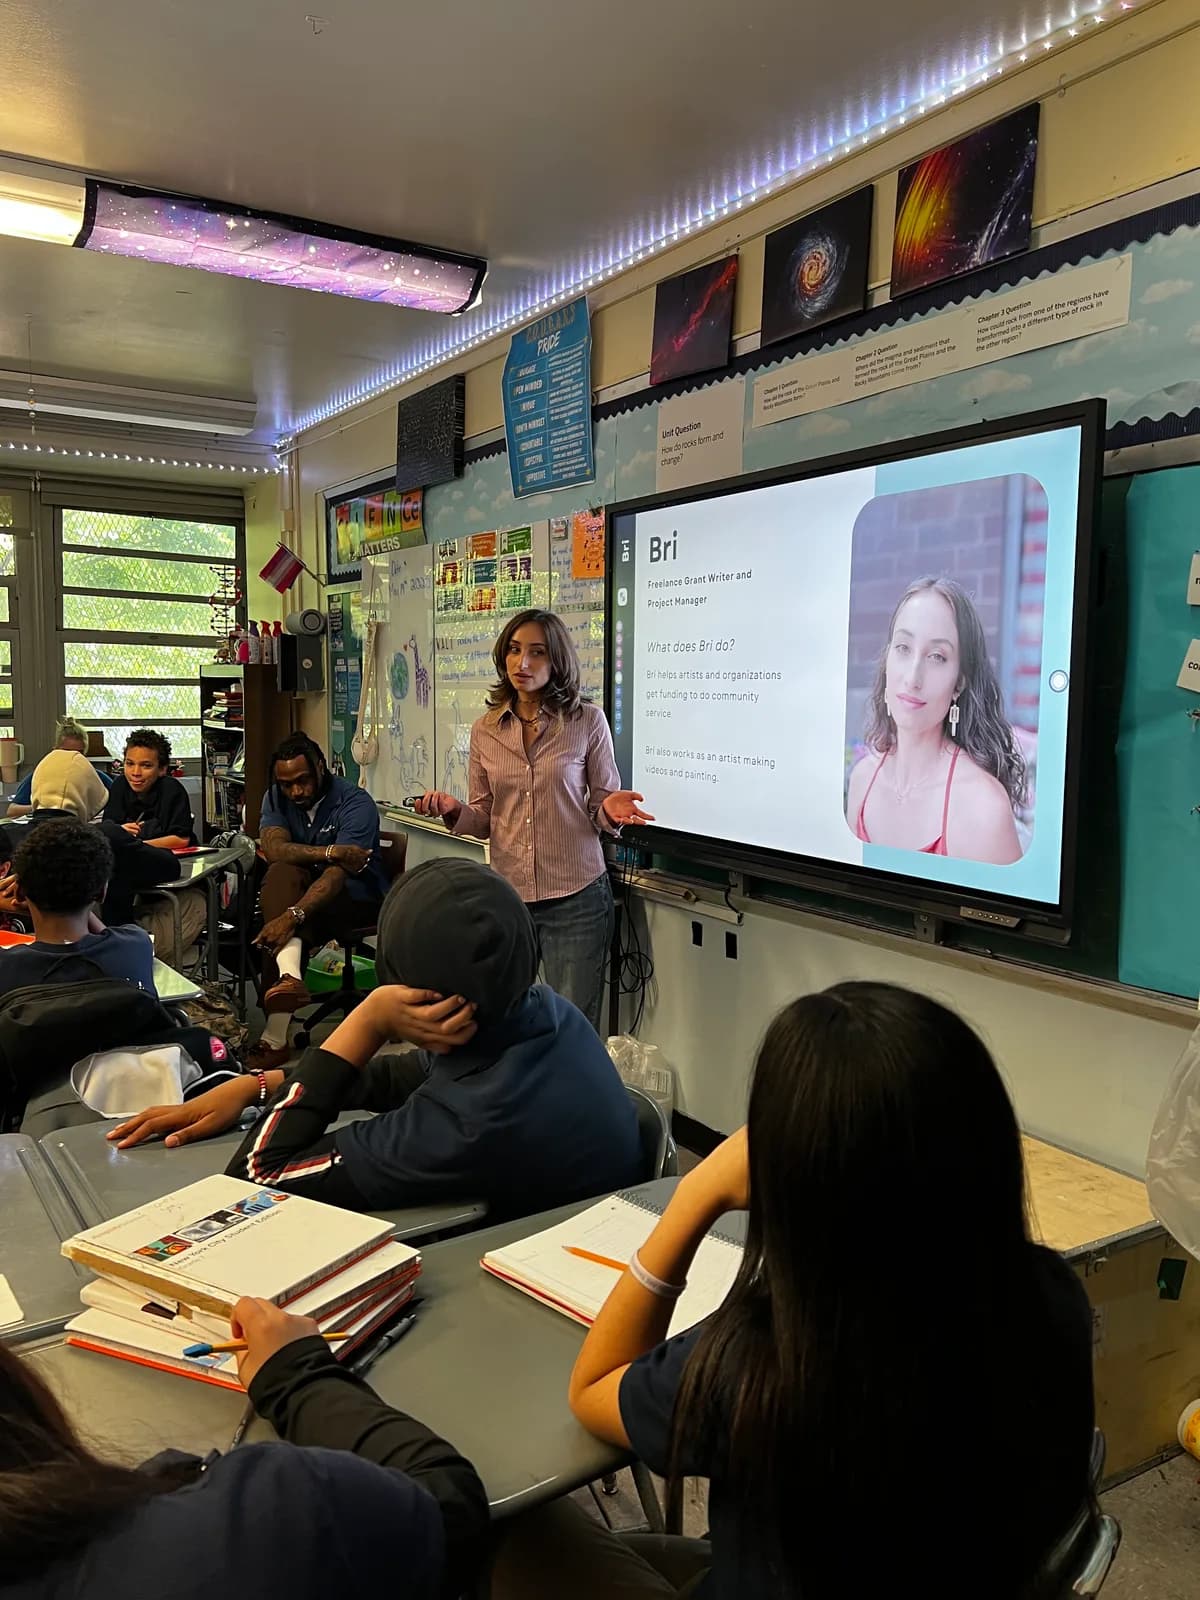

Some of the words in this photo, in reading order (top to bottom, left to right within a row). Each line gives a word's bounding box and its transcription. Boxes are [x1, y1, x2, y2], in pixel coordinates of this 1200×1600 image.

[977, 326, 989, 335] How
[989, 321, 1005, 331] could
[1005, 316, 1017, 325] rock
[1018, 312, 1033, 321] from
[1033, 308, 1046, 316] one
[1046, 304, 1055, 312] of
[1055, 301, 1065, 310] the
[1066, 294, 1092, 307] regions
[1093, 289, 1109, 299] have
[978, 312, 999, 324] Chapter
[1000, 308, 1005, 316] 3
[1005, 301, 1032, 315] Question
[976, 328, 1010, 344] transformed
[1010, 322, 1021, 332] into
[1027, 314, 1054, 327] different
[1055, 310, 1070, 320] type
[1071, 307, 1079, 315] of
[1079, 303, 1094, 313] rock
[1095, 300, 1103, 308] in
[537, 331, 561, 357] PRIDE
[877, 343, 898, 355] Question
[938, 338, 950, 346] that
[976, 344, 985, 352] the
[985, 339, 1000, 349] other
[1001, 331, 1022, 345] region?
[903, 355, 919, 364] Great
[662, 428, 674, 438] Unit
[675, 422, 701, 436] Question
[661, 445, 673, 454] How
[674, 442, 681, 451] do
[682, 439, 697, 449] rocks
[697, 435, 712, 445] form
[712, 431, 724, 442] and
[661, 453, 683, 466] change?
[621, 539, 630, 562] Bri
[649, 530, 678, 563] Bri
[647, 579, 683, 589] Freelance
[684, 576, 706, 585] Grant
[708, 571, 734, 583] Writer
[736, 569, 752, 580] and
[647, 597, 673, 609] Project
[675, 595, 708, 607] Manager
[647, 640, 671, 653] What
[673, 640, 697, 652] does
[699, 638, 714, 652] Bri
[715, 638, 736, 651] do?
[646, 670, 656, 679] Bri
[657, 670, 677, 681] helps
[679, 669, 703, 680] artists
[705, 670, 720, 680] and
[722, 669, 782, 681] organizations
[646, 690, 658, 700] get
[659, 689, 688, 701] funding
[689, 690, 698, 700] to
[699, 690, 710, 700] do
[711, 690, 759, 703] community
[645, 709, 671, 718] service
[645, 745, 655, 755] Bri
[656, 746, 671, 757] also
[672, 749, 694, 759] works
[696, 751, 705, 760] as
[707, 752, 717, 761] an
[718, 753, 741, 764] artist
[743, 755, 775, 769] making
[645, 765, 668, 776] videos
[669, 767, 684, 778] and
[684, 769, 719, 784] painting.
[169, 1256, 190, 1267] New
[190, 1247, 208, 1260] York
[207, 1237, 227, 1249] City
[228, 1221, 256, 1240] Student
